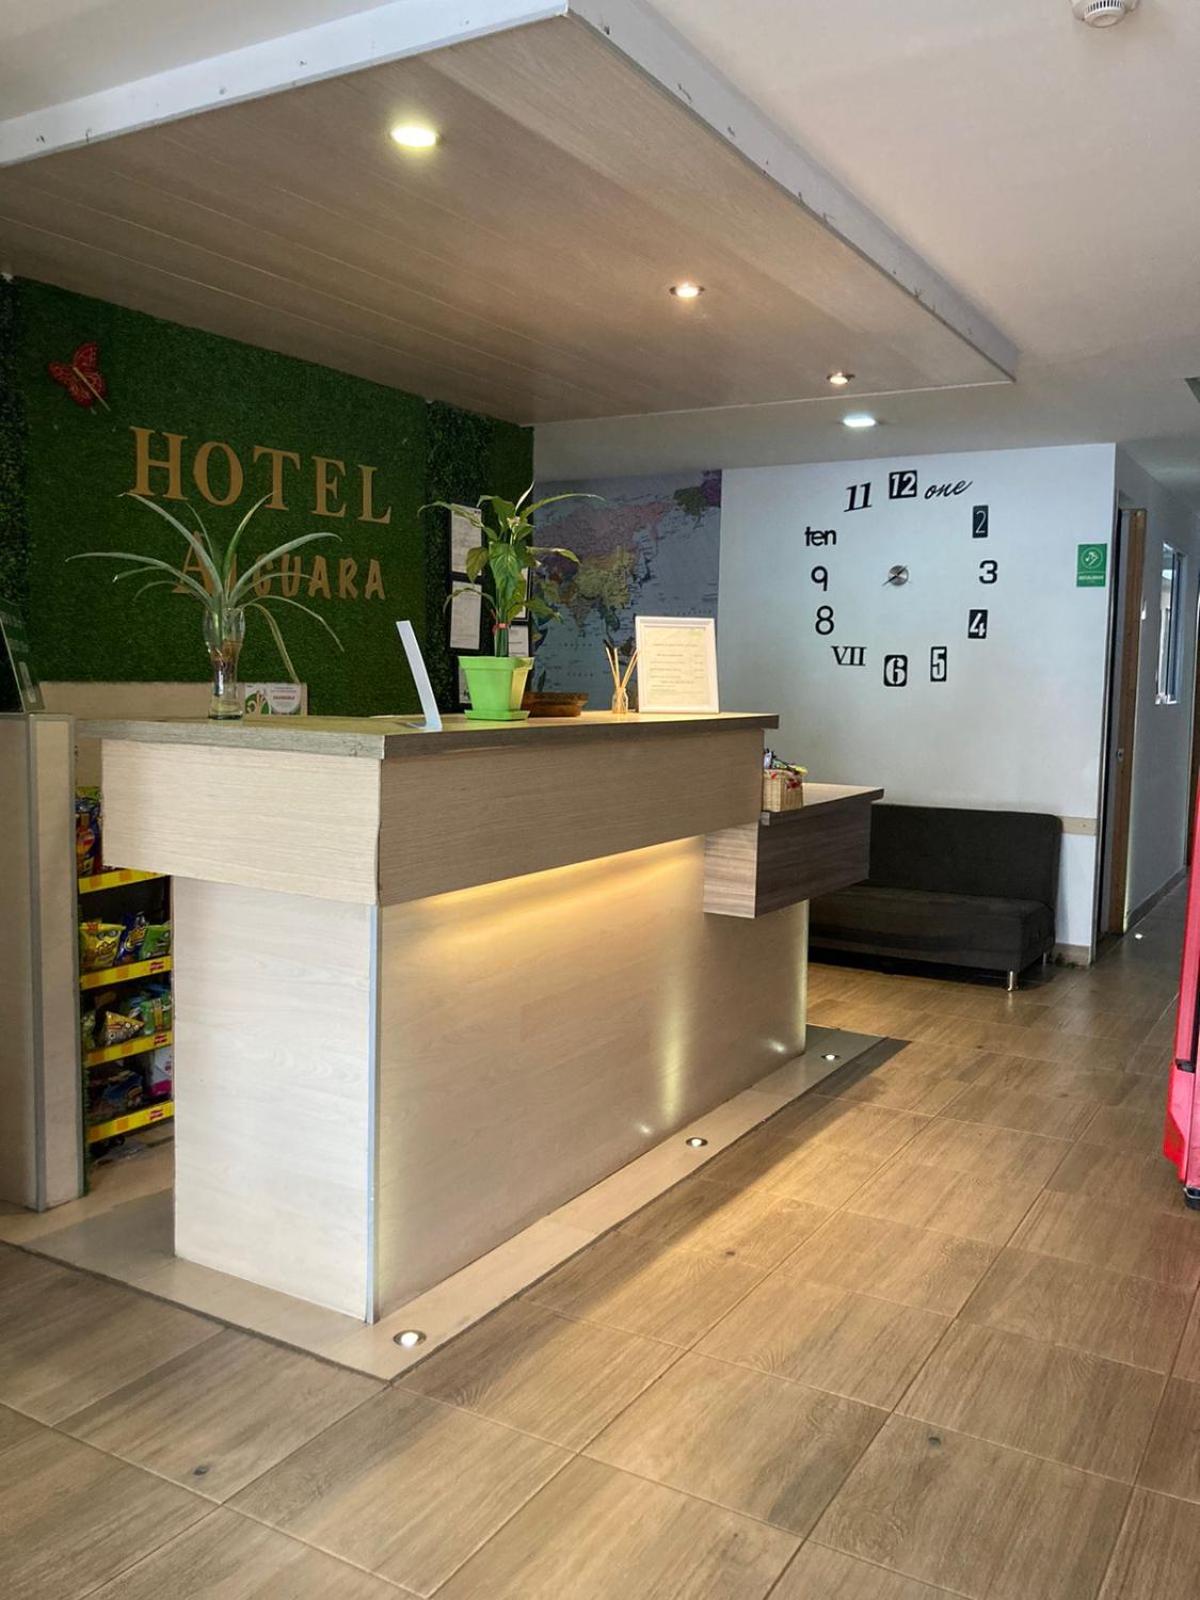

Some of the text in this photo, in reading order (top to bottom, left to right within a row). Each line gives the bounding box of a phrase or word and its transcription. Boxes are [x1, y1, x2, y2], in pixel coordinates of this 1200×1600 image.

[129, 426, 392, 525] HOTEL
[890, 471, 917, 498] 12
[843, 481, 873, 512] 11
[924, 479, 973, 500] one
[974, 508, 988, 535] 2
[804, 526, 837, 547] ten
[811, 565, 829, 592] 9
[978, 559, 999, 585] 3
[815, 605, 835, 636] 8
[969, 611, 987, 638] 4
[831, 645, 867, 667] VII
[931, 647, 946, 681] 5
[884, 656, 907, 686] 6
